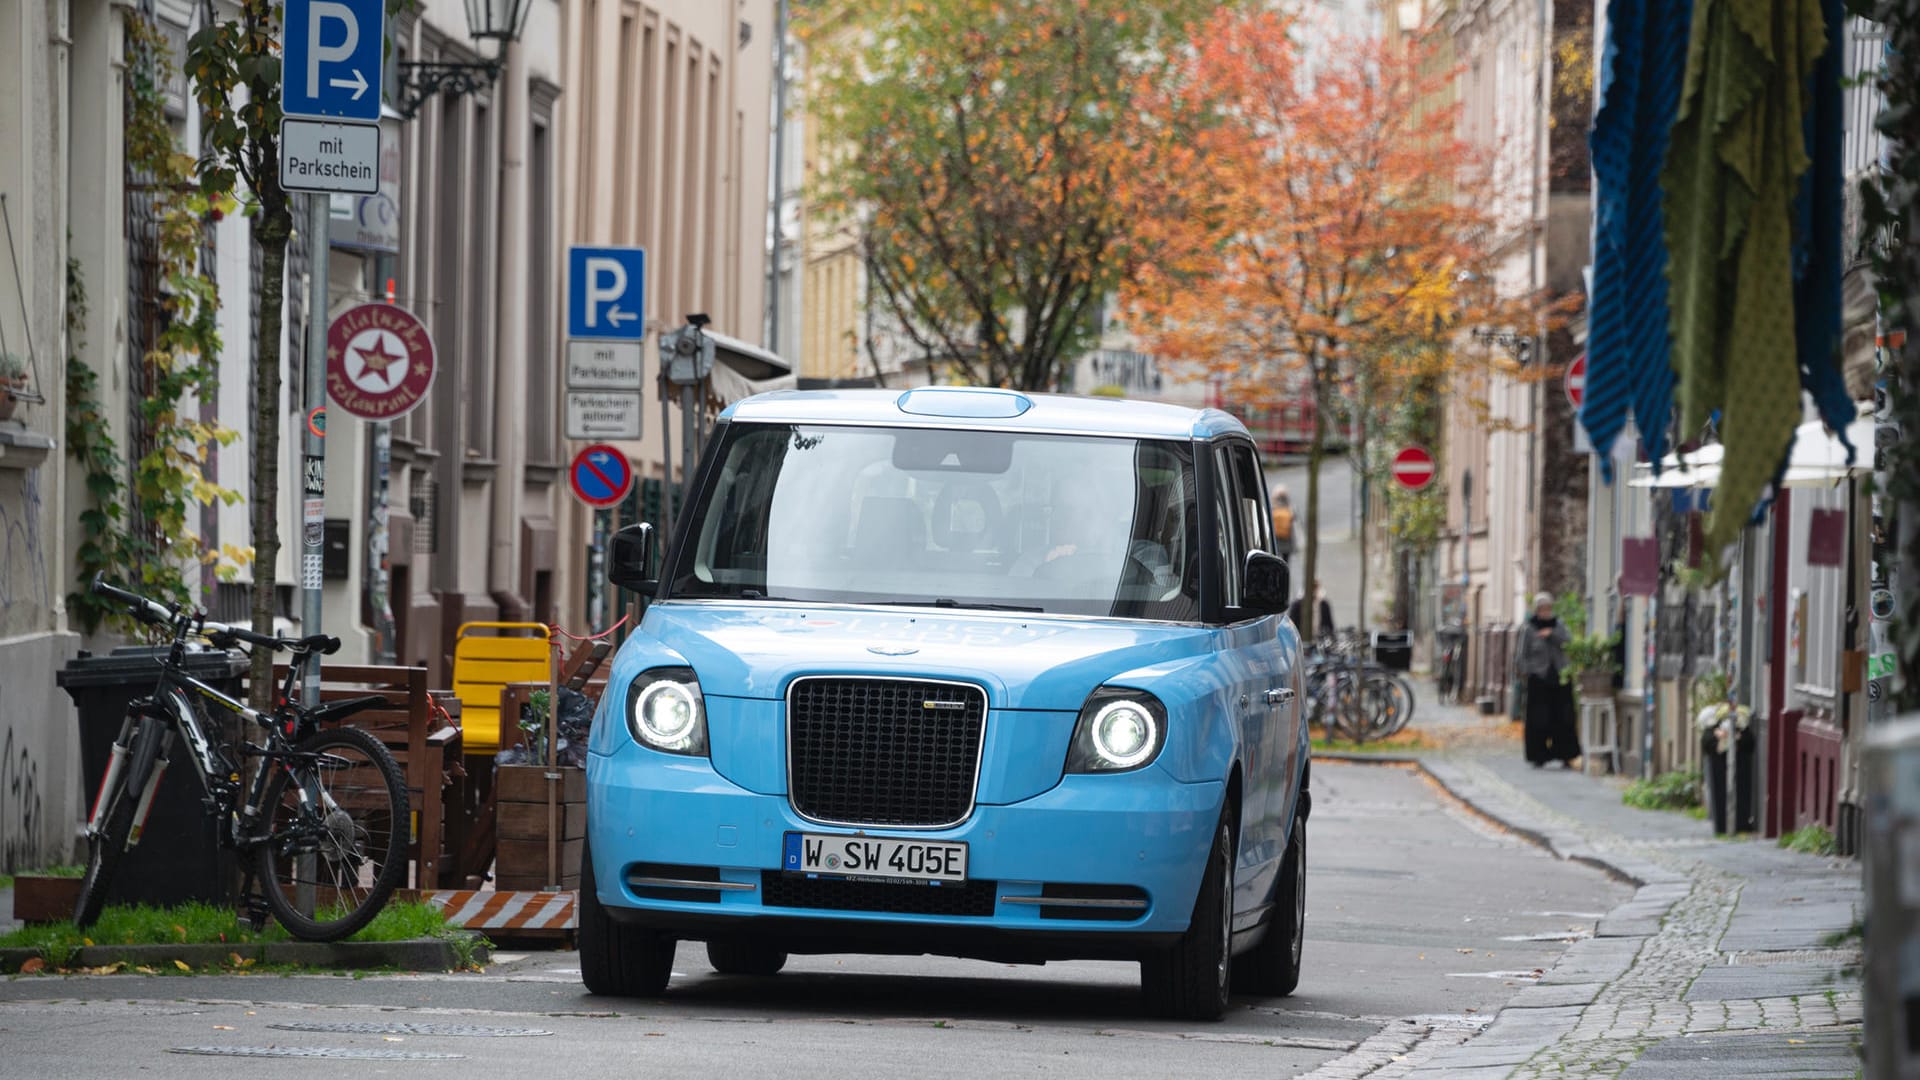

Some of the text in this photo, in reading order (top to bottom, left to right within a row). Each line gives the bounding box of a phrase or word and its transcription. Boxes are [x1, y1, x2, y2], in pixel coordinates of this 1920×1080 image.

[306, 1, 359, 98] P
[319, 137, 343, 155] mit
[289, 157, 371, 179] Parkschein
[585, 257, 627, 328] P
[594, 349, 616, 360] mit
[571, 366, 638, 379] Parkschein
[582, 411, 626, 422] automat
[789, 839, 963, 876] D W SW 405E
